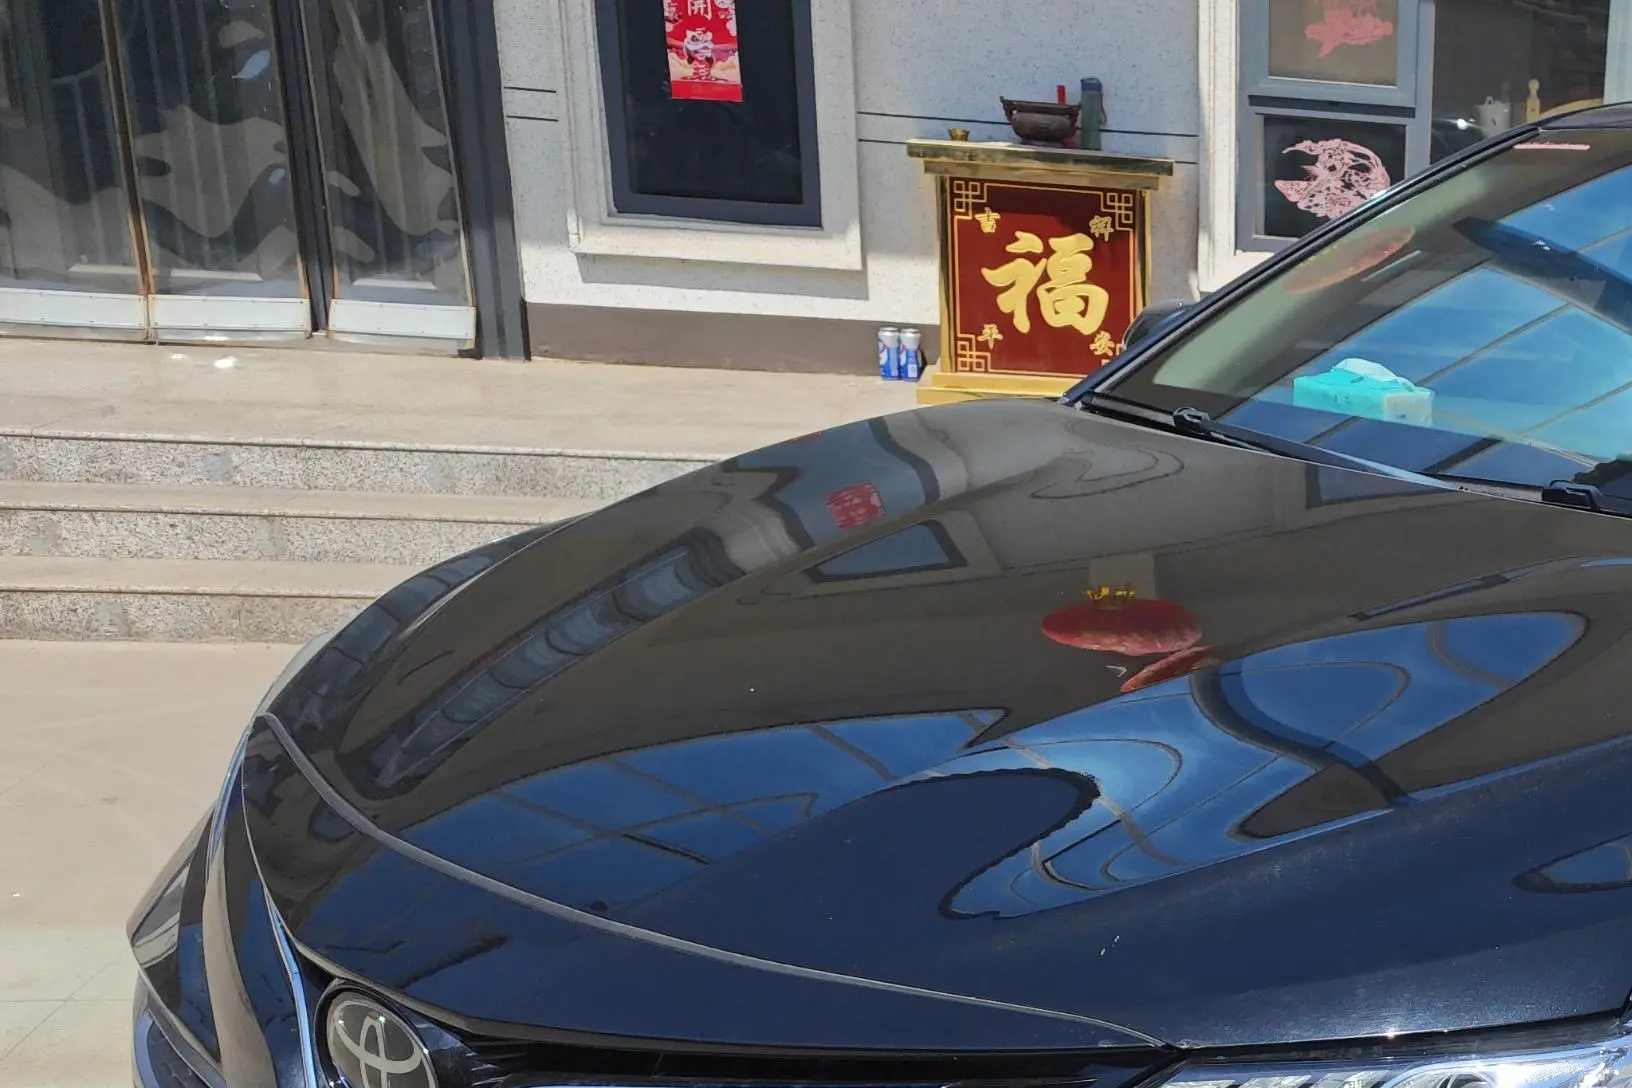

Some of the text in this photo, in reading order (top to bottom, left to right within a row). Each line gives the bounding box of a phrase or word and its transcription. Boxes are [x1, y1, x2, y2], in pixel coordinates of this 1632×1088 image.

[980, 230, 1110, 336] 福
[977, 323, 1115, 357] 平 安
